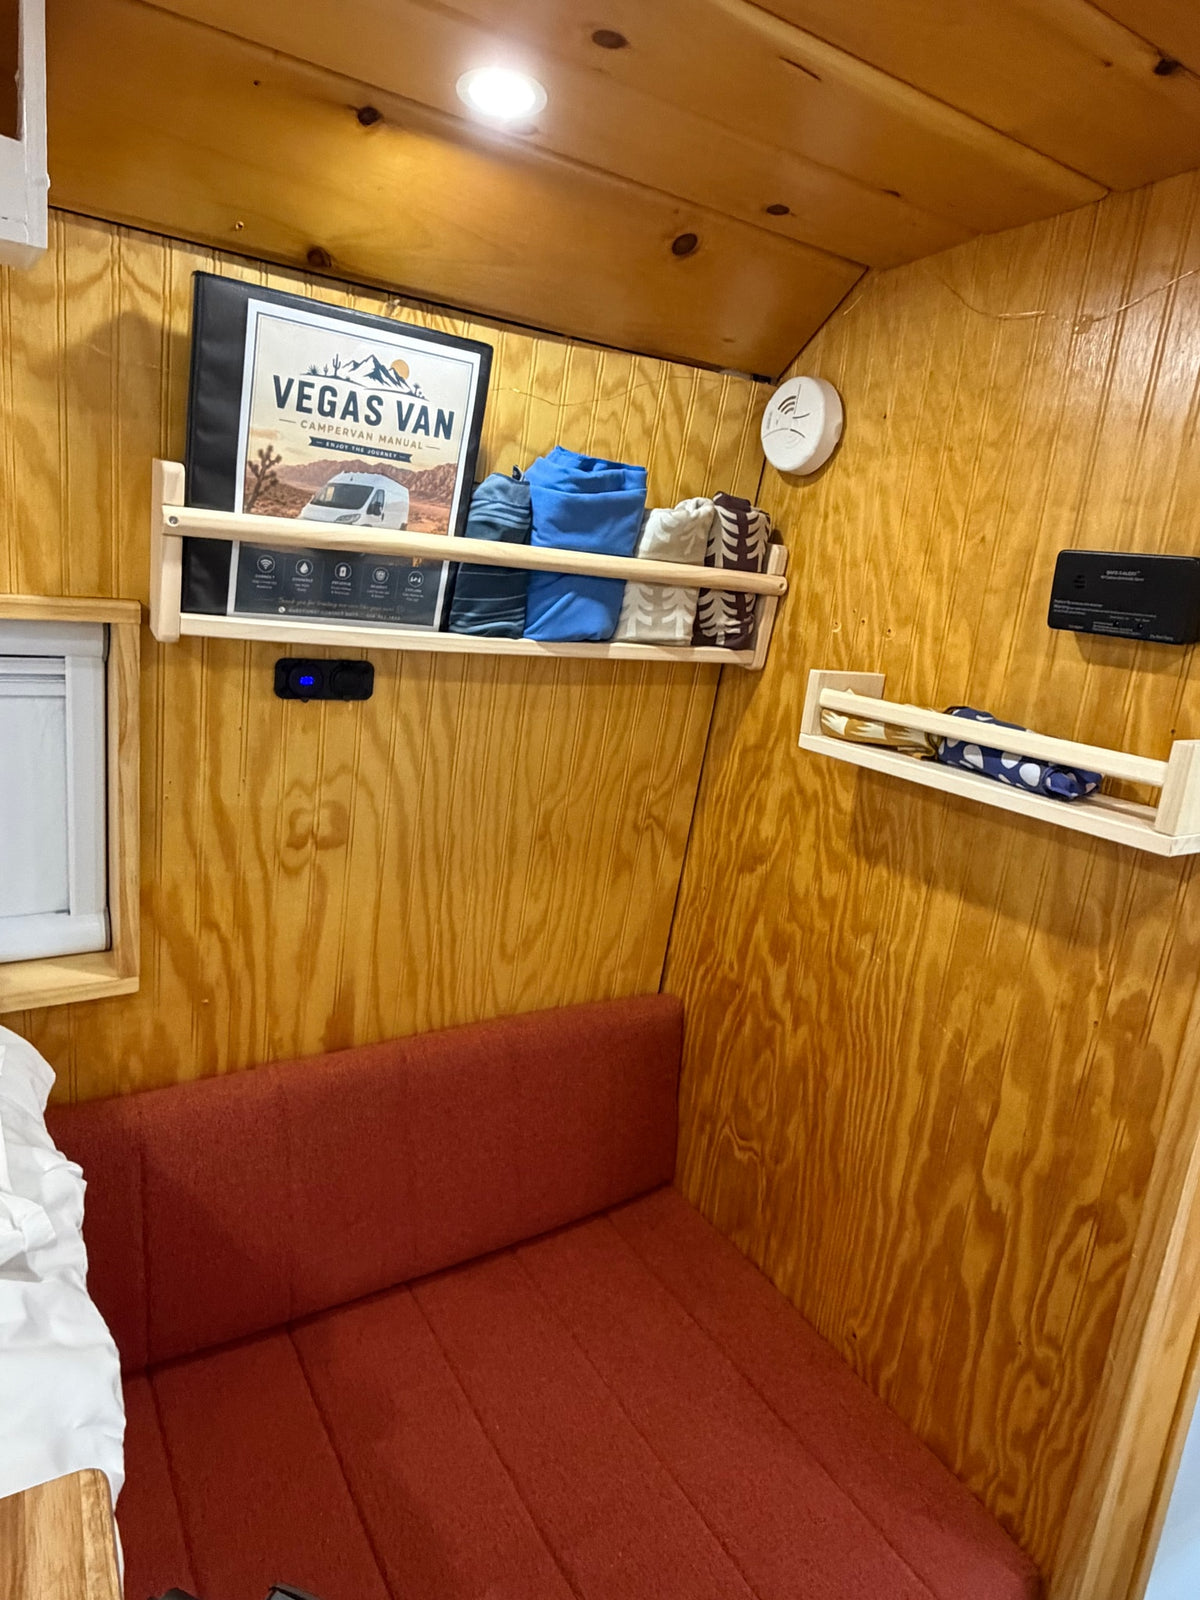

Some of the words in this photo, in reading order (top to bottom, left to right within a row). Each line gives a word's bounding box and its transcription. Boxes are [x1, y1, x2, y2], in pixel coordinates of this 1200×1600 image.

[272, 374, 384, 427] VEGAS
[396, 400, 455, 440] VAN
[300, 419, 374, 441] CAMPERVAN
[378, 434, 423, 450] MANUAL
[325, 441, 349, 451] ENJOY
[351, 445, 365, 453] THE
[367, 449, 397, 459] JOURNEY
